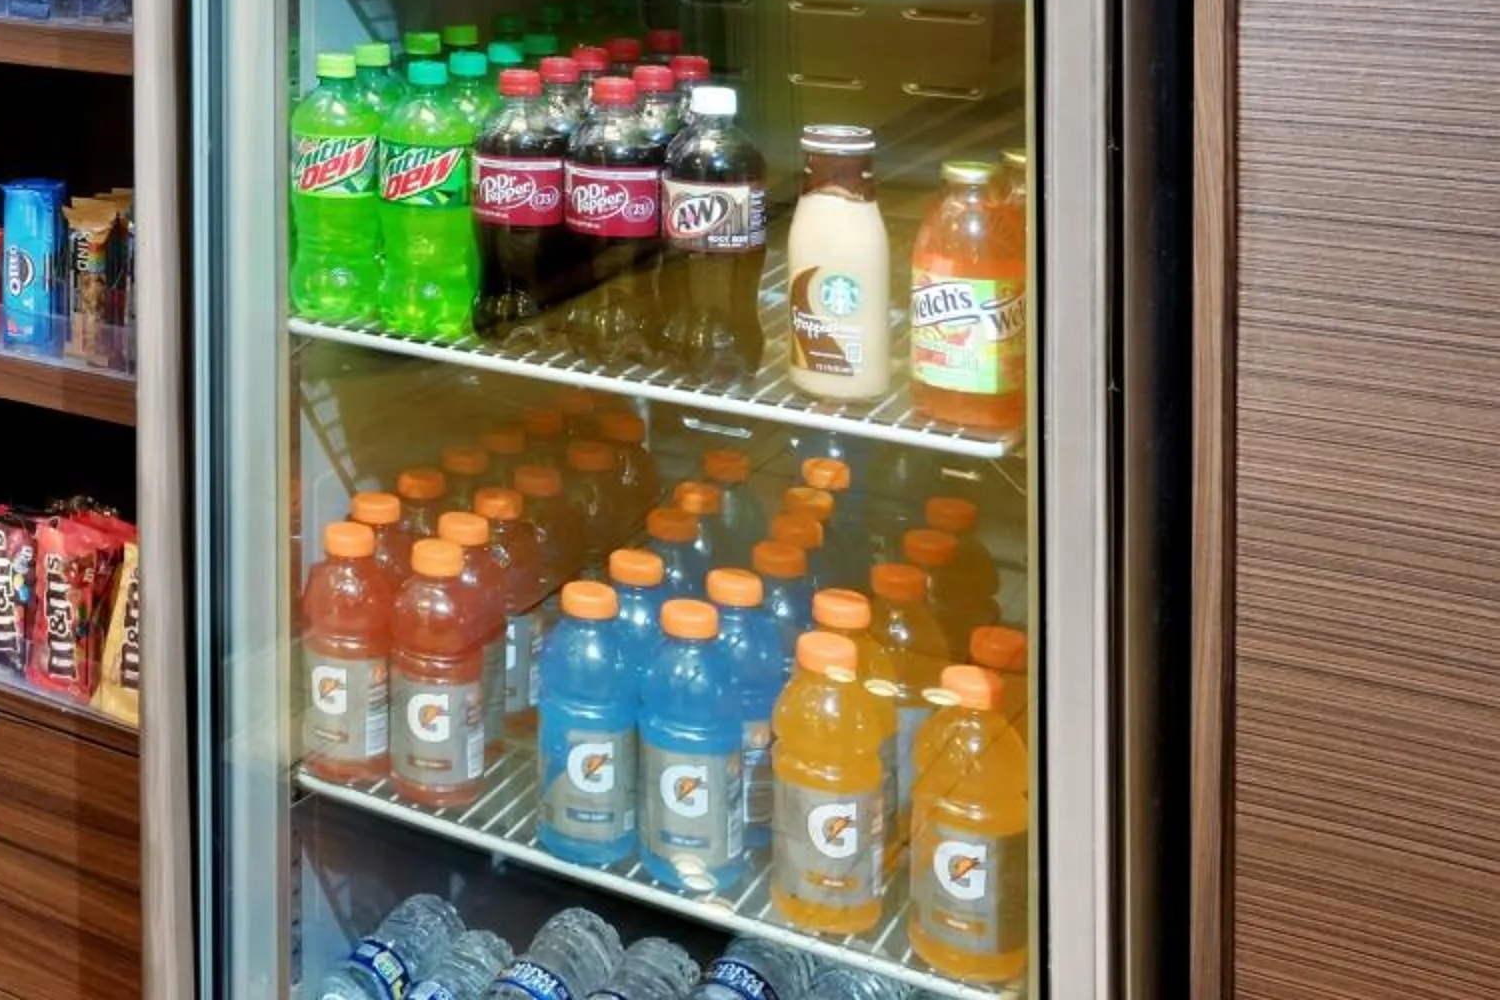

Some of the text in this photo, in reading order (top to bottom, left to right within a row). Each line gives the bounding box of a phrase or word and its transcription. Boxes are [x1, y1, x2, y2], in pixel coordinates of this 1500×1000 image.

[484, 176, 533, 204] Pepper
[575, 185, 626, 214] Pepper
[75, 229, 93, 272] KIND
[913, 287, 973, 319] elch's
[312, 665, 347, 715] G
[407, 693, 450, 743] G
[567, 742, 615, 793] G
[660, 764, 709, 818] G
[808, 802, 857, 859] G
[933, 840, 987, 901] G
